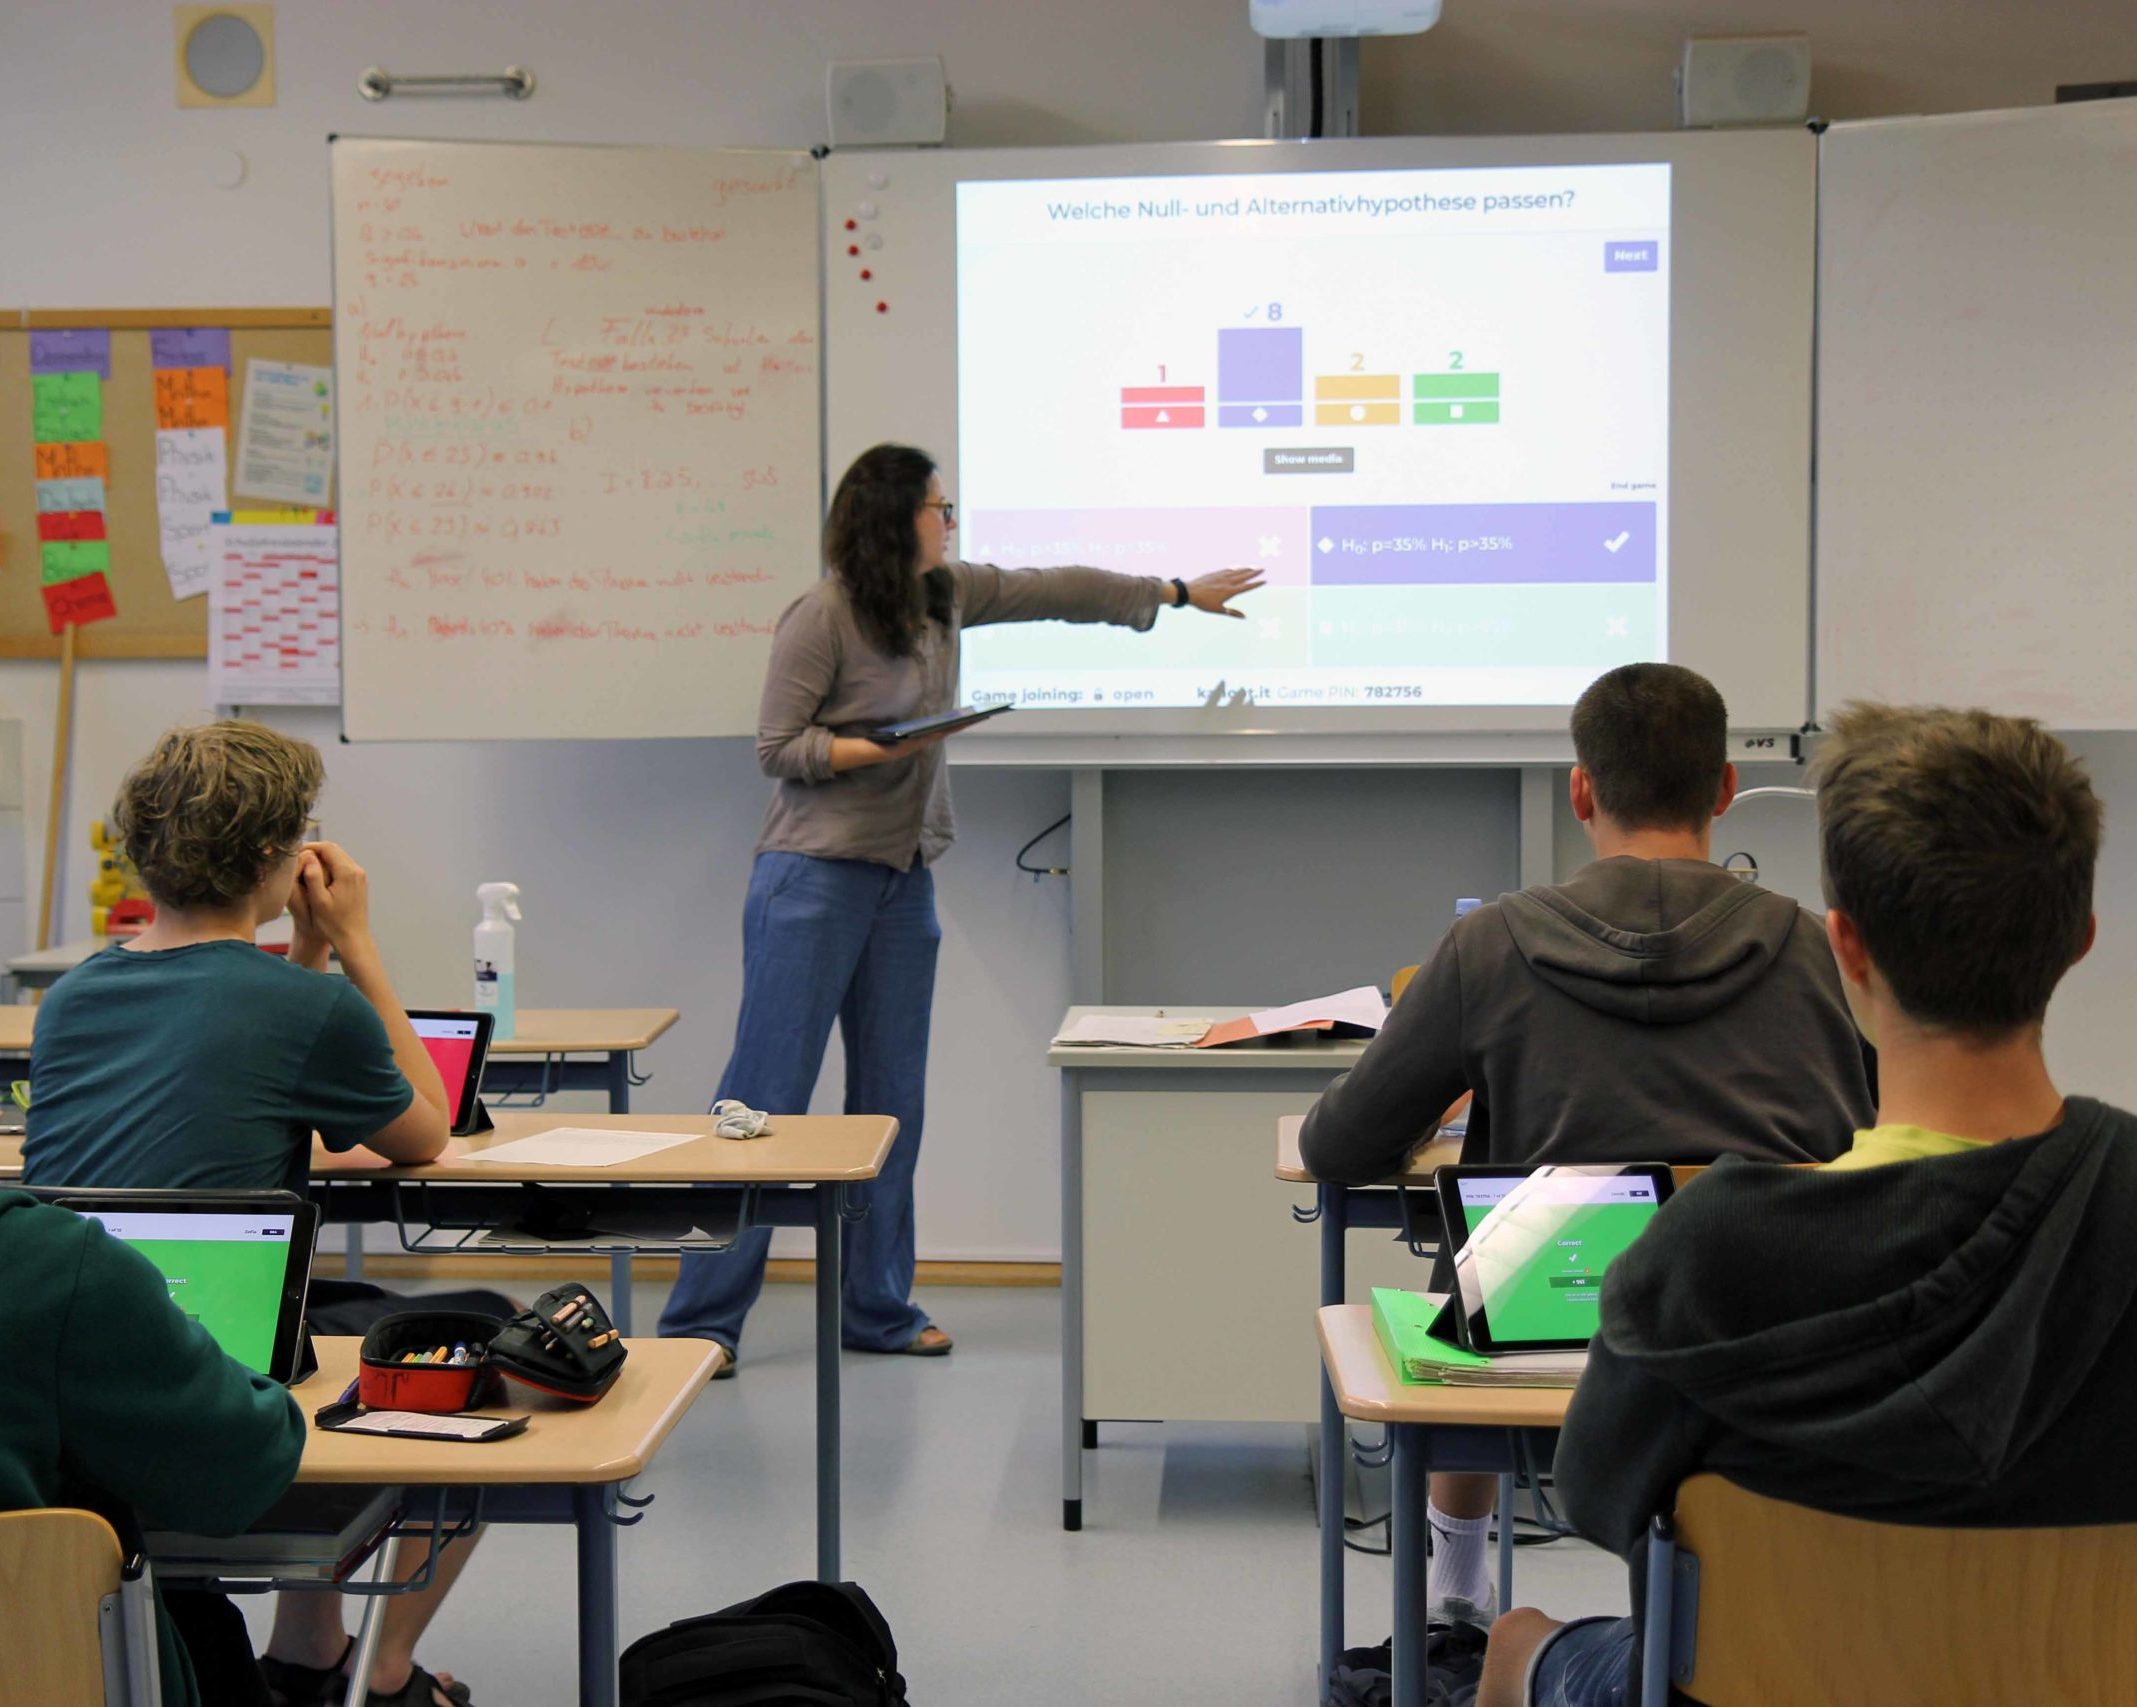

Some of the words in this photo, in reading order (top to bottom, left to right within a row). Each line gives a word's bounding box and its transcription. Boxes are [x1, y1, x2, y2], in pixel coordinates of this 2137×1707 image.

[1048, 201, 1131, 220] Welche
[1138, 199, 1189, 218] Null-
[1196, 198, 1240, 217] und
[1246, 190, 1476, 217] Alternativhypothese
[1483, 190, 1575, 213] passen?
[1614, 250, 1649, 261] Next
[1267, 303, 1283, 322] 8
[1351, 353, 1364, 371] 2
[1448, 351, 1464, 370] 2
[1156, 364, 1167, 384] 1
[1274, 454, 1305, 465] Show
[1307, 452, 1343, 464] media
[1372, 538, 1425, 554] p=35%
[1458, 536, 1513, 552] p>35%
[971, 690, 1017, 703] Game
[1022, 688, 1083, 703] joining:
[1113, 689, 1154, 702] open
[1278, 686, 1325, 699] Game
[1365, 686, 1422, 698] 782756
[1557, 1239, 1583, 1247] Correct
